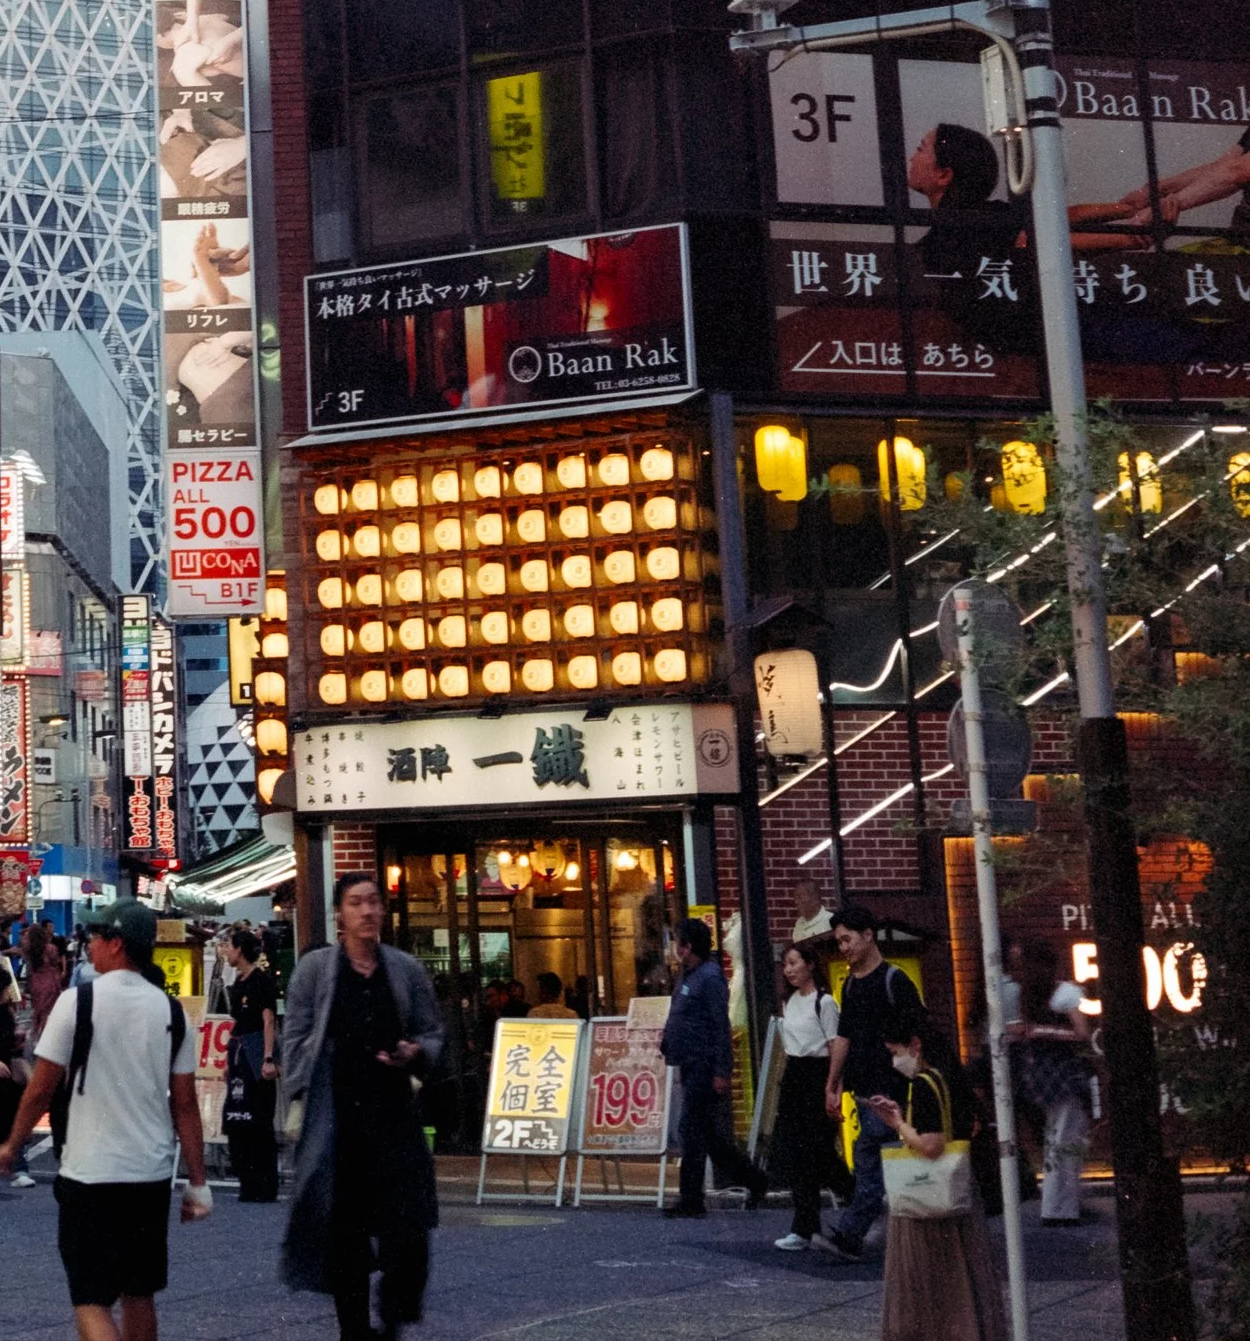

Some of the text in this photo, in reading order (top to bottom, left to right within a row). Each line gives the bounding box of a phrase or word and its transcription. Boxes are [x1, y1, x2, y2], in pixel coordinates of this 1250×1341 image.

[178, 91, 225, 105] アロマ
[789, 92, 856, 144] 3F
[316, 268, 535, 320] 本格タイ古式マッサージ
[187, 314, 228, 328] リフレ
[547, 337, 679, 378] Baan Rak
[337, 389, 365, 414] 3F
[173, 460, 254, 483] PIZZA
[173, 488, 211, 504] ALL
[174, 505, 256, 540] 500
[221, 582, 259, 599] B1F
[152, 629, 174, 774] ヨドバシカメラ
[651, 712, 664, 790] レモンサワー
[669, 710, 686, 789] アサヒビール
[129, 775, 151, 848] ー・おもちゃ館
[591, 1071, 659, 1128] 199
[492, 1119, 533, 1149] 2F
